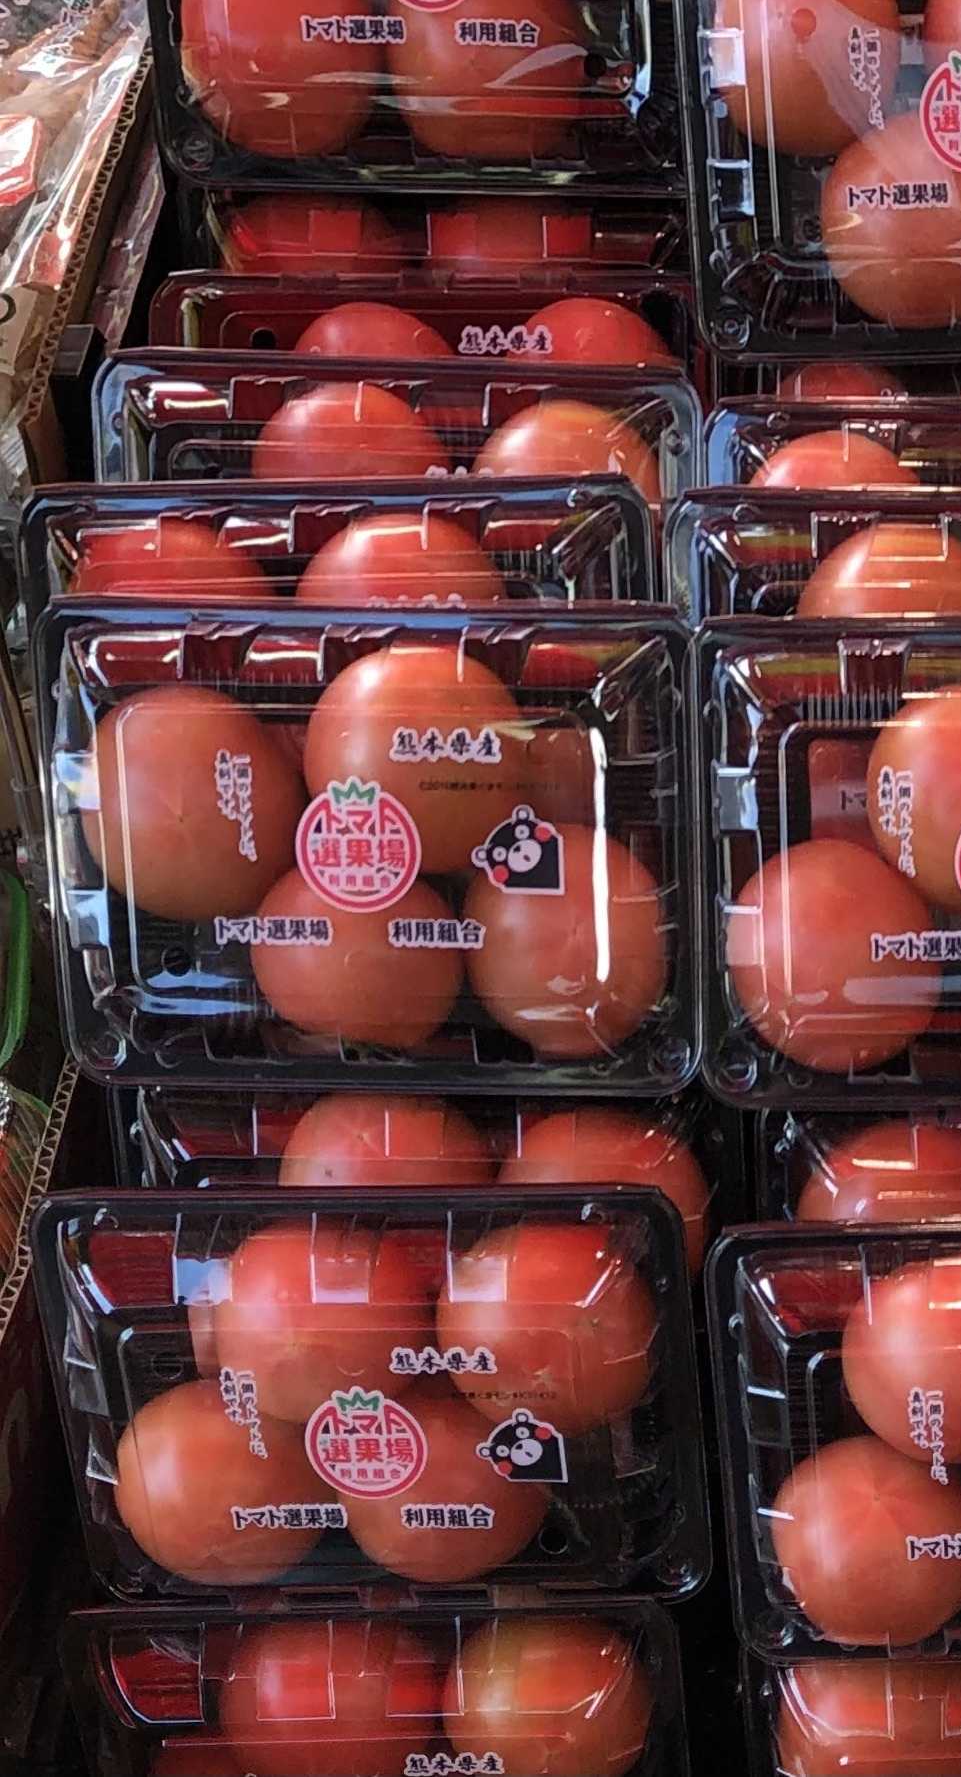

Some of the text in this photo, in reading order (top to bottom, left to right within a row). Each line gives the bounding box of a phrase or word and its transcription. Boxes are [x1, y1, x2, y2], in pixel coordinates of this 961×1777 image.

[304, 19, 538, 43] トマト選果場 利用組合
[848, 183, 949, 207] トマト選果場
[461, 329, 549, 352] 熊本県産
[392, 730, 499, 757] 熊本県産
[325, 808, 398, 835] トマト
[312, 838, 406, 868] 選果場
[217, 919, 482, 946] トマト選果場 利用組合
[393, 1350, 495, 1372] 熊本県産
[332, 1412, 402, 1435] トマト
[321, 1438, 414, 1463] 選果場
[234, 1506, 493, 1529] トマト選果場 利用組合
[407, 1755, 501, 1773] 熊本県産
